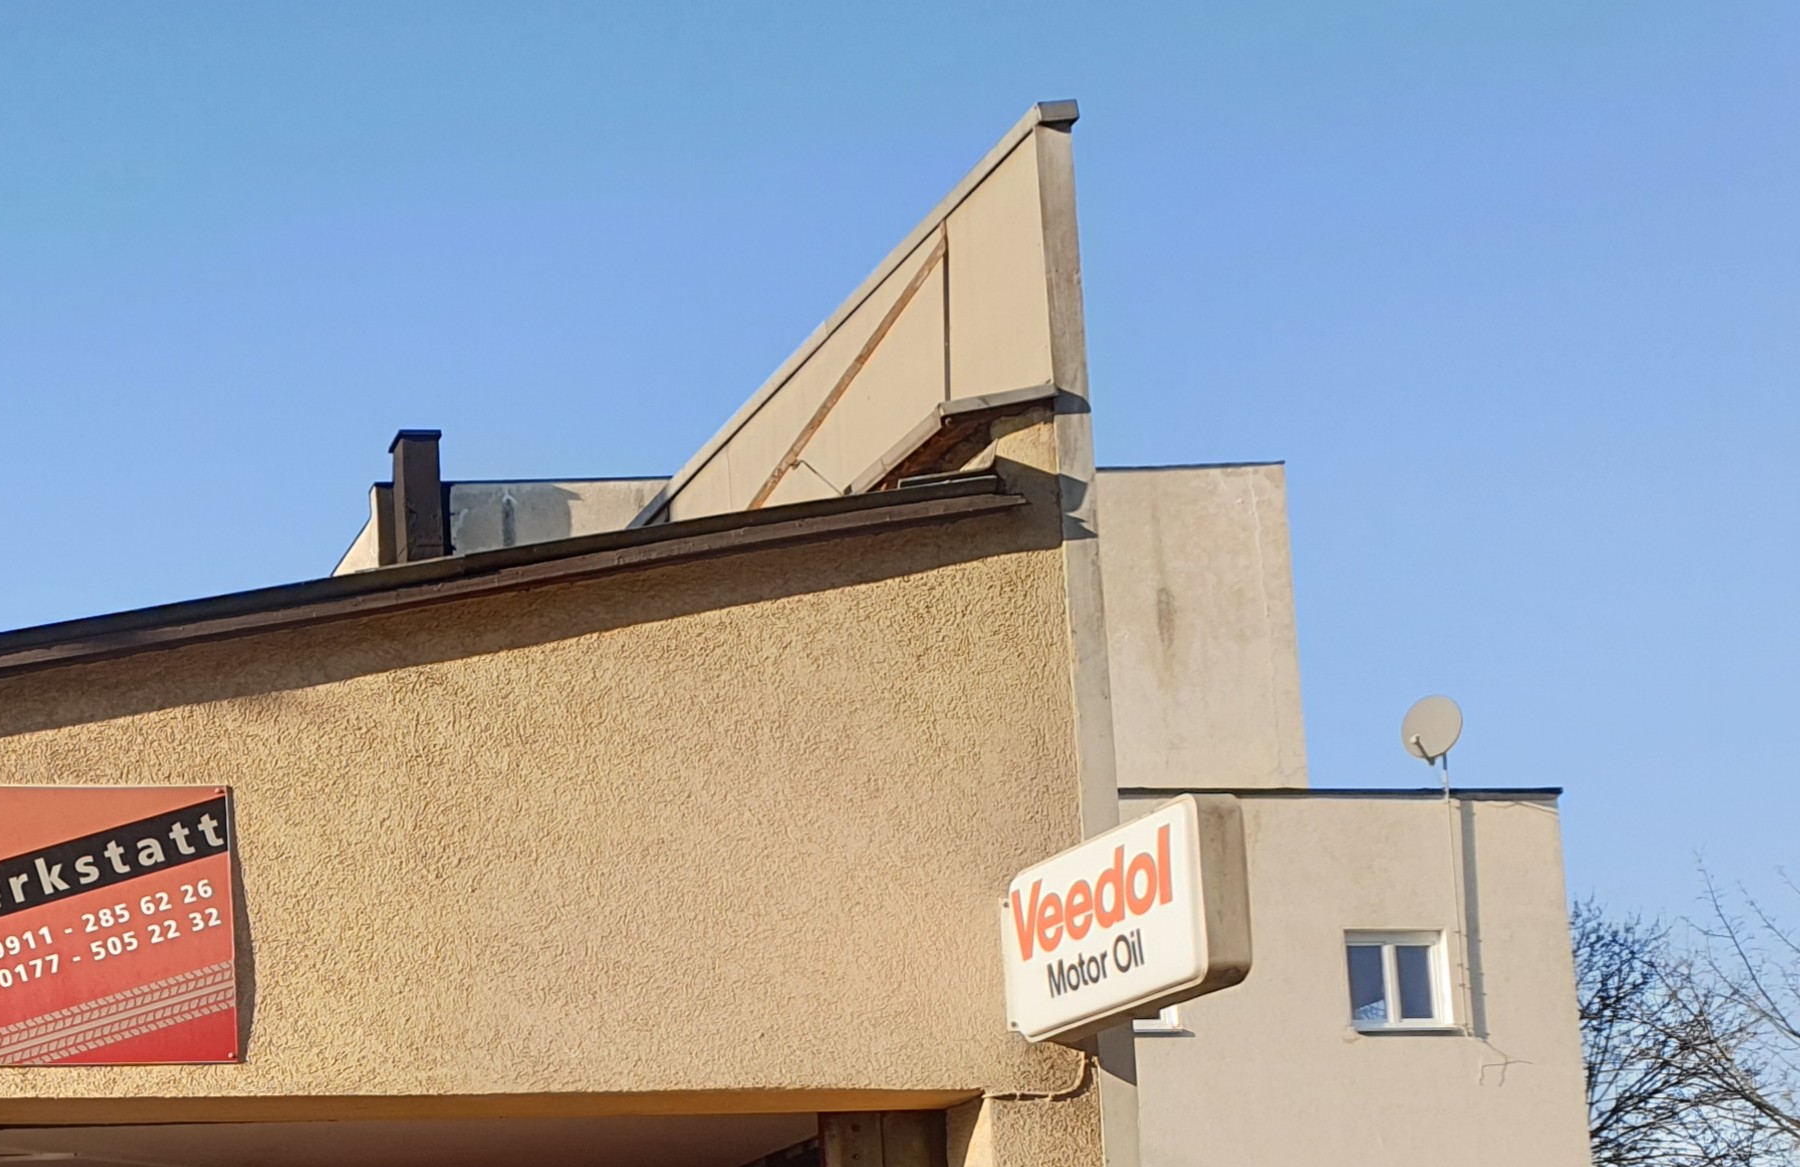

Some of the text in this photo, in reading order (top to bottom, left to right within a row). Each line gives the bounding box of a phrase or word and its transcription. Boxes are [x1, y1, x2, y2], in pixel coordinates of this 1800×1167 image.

[81, 903, 130, 934] 285
[139, 892, 172, 915] 62
[180, 879, 213, 904] 26
[1011, 823, 1174, 962] Veedol
[90, 931, 139, 961] 505
[148, 919, 181, 944] 22
[188, 907, 221, 932] 32
[1047, 928, 1145, 999] Motor Oil
